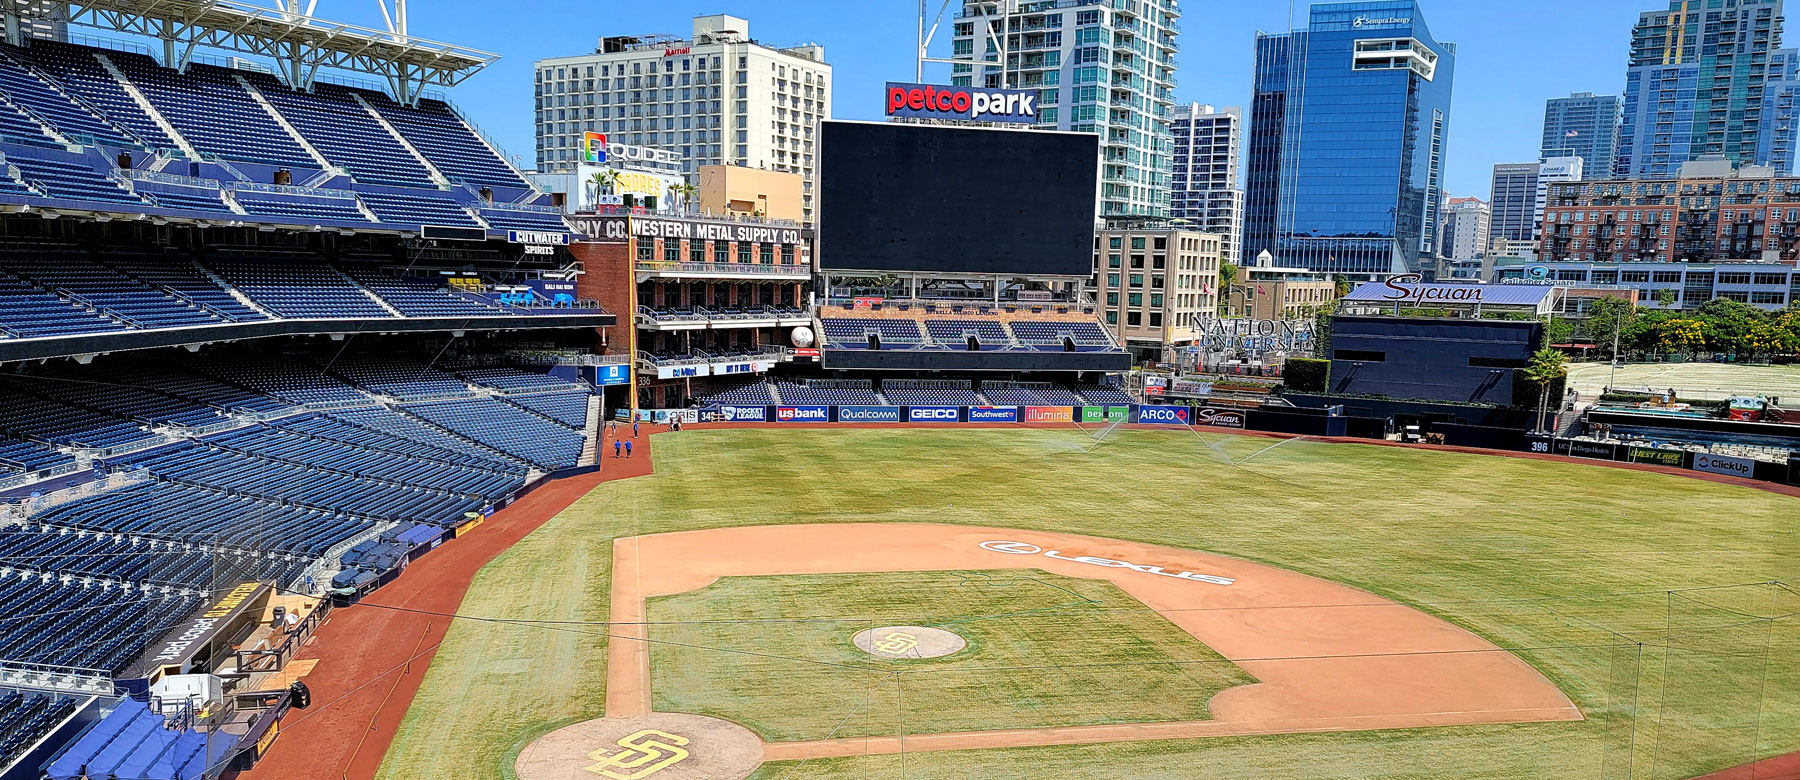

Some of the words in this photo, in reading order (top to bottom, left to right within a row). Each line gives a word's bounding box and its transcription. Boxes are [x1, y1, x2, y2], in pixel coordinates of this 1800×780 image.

[1366, 17, 1388, 25] Sempra
[1389, 16, 1411, 24] Energy
[664, 47, 690, 57] Marriott
[616, 173, 661, 198] PADRES
[631, 219, 691, 237] WESTERN
[696, 224, 734, 241] METAL
[737, 226, 778, 243] SUPPLY
[782, 230, 800, 244] CO.
[515, 231, 564, 245] CUTWATER
[524, 245, 554, 255] SPIRITS
[1501, 277, 1543, 287] Gallagher
[1382, 273, 1485, 308] Sycuan
[681, 367, 697, 376] Mitel
[638, 376, 650, 386] 336
[841, 408, 897, 419] Qualcomm
[911, 409, 957, 419] GEICO
[1028, 409, 1069, 420] illumina
[1140, 409, 1175, 420] ARCO
[1199, 409, 1240, 424] Sycuan
[1531, 441, 1548, 452] 396
[1711, 459, 1749, 474] ClickUp
[1043, 550, 1235, 586] LEXUS
